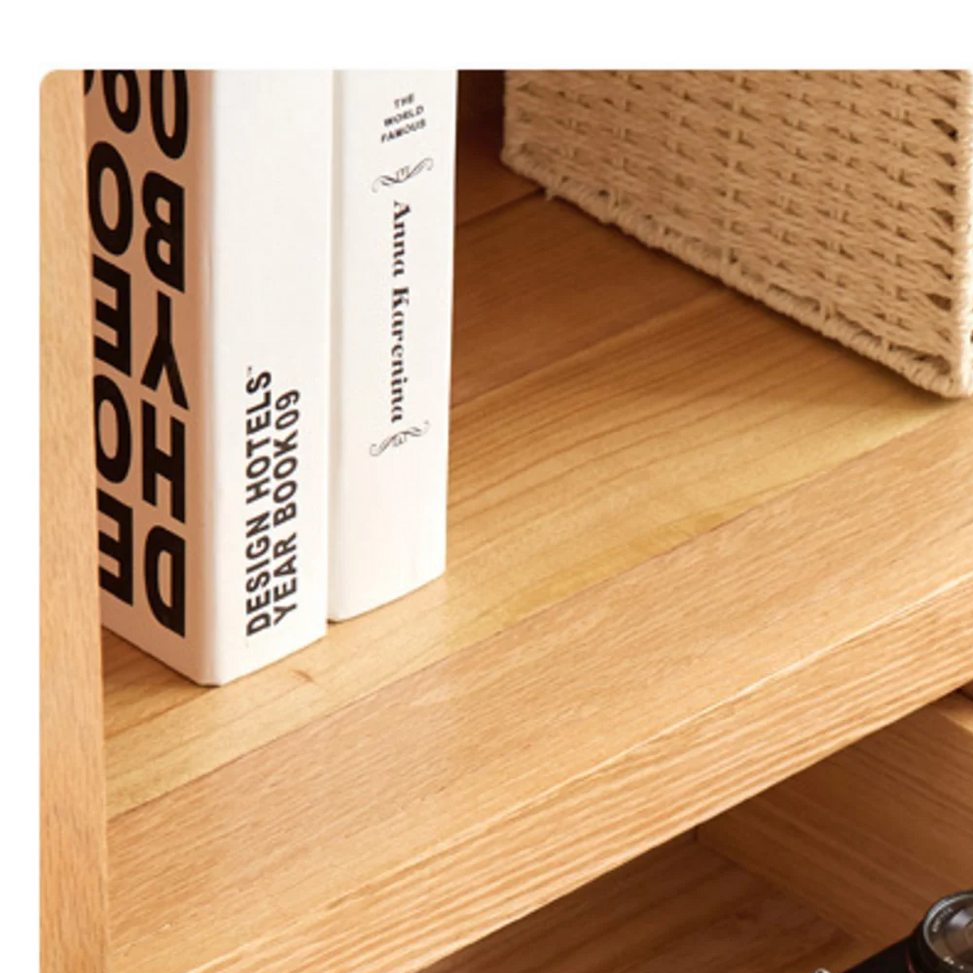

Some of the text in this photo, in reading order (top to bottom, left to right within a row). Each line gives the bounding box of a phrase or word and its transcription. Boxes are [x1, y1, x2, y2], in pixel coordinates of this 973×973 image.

[380, 118, 427, 143] FAMOUS
[383, 104, 424, 127] WORLD
[393, 93, 414, 109] THE
[391, 200, 412, 424] Anna Karenina
[245, 370, 272, 637] DESIGN HOTELS
[272, 531, 298, 626] YEAR
